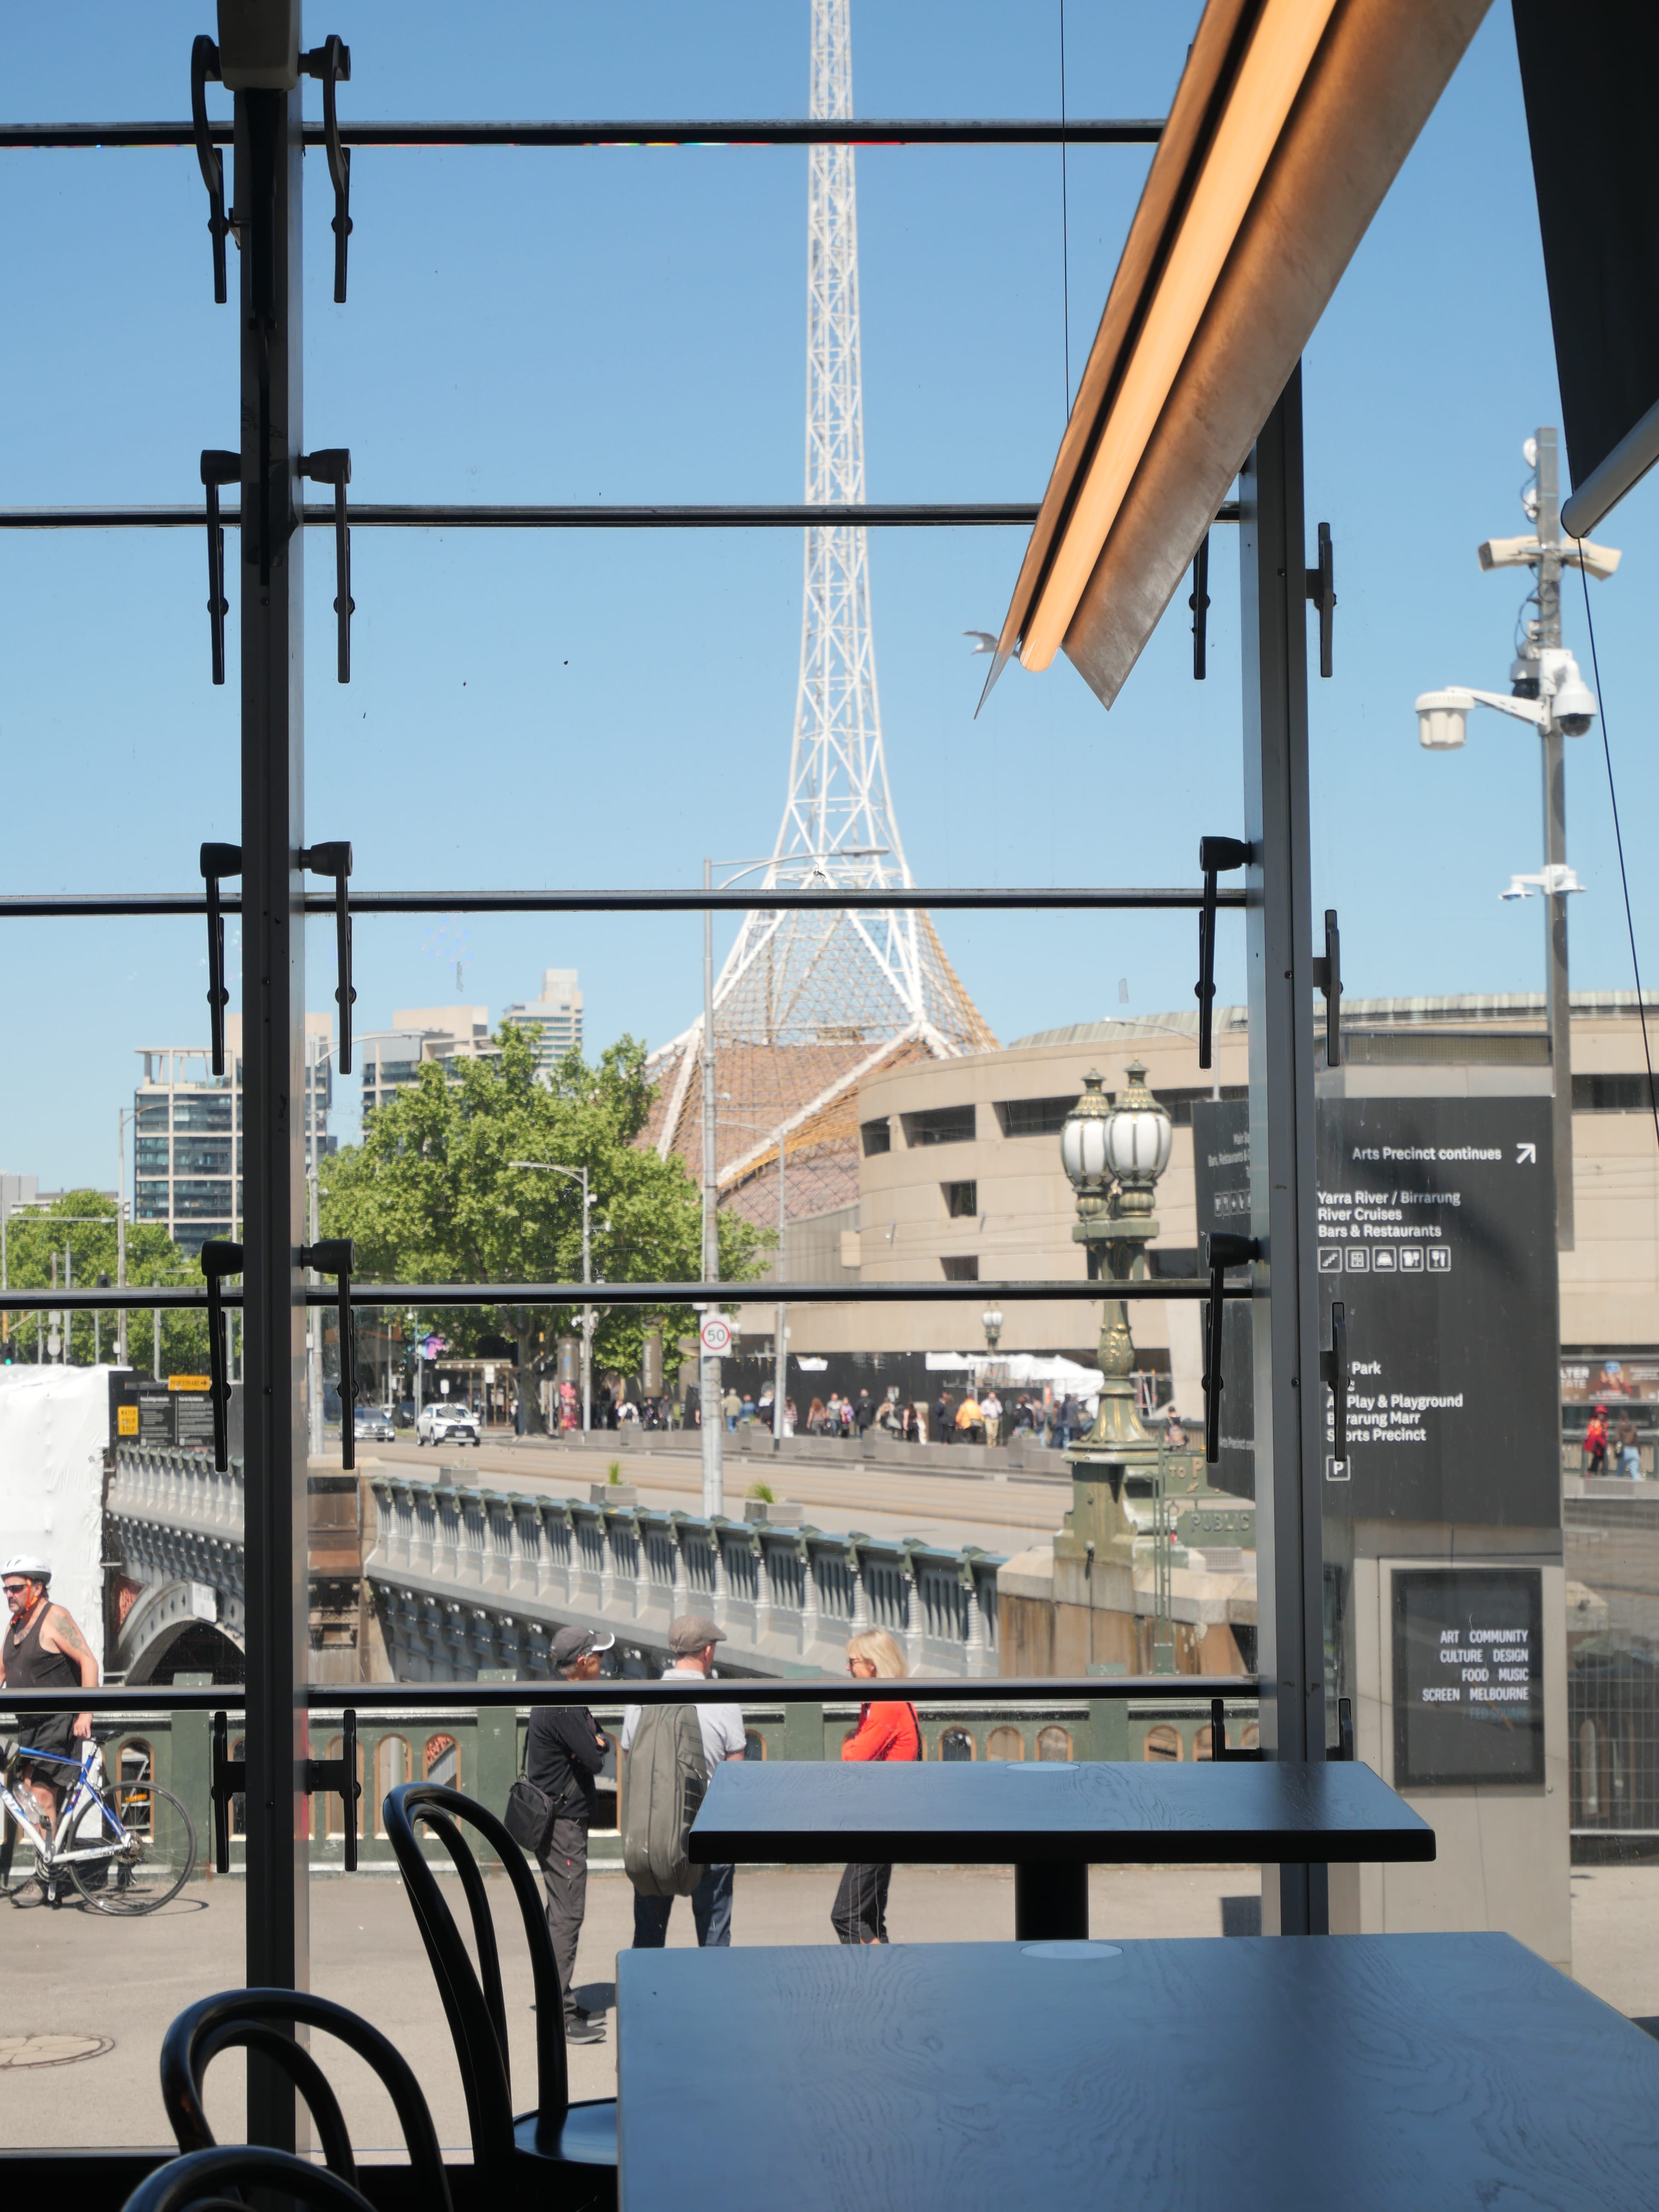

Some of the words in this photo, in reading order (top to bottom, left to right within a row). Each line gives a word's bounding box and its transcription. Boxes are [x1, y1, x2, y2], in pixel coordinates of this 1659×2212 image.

[1352, 1147, 1379, 1160] Arts
[1382, 1146, 1436, 1160] Precinct
[1438, 1146, 1502, 1160] continues
[1317, 1191, 1352, 1204] Yarra
[1355, 1190, 1388, 1204] River
[1391, 1190, 1397, 1205] /
[1400, 1190, 1461, 1206] Birrarung
[1318, 1207, 1352, 1220] River
[1354, 1207, 1402, 1220] Cruises
[1318, 1225, 1348, 1237] Bars
[1350, 1224, 1360, 1237] &
[1363, 1224, 1442, 1237] Restaurants
[707, 1330, 725, 1342] 50
[1352, 1361, 1381, 1374] Park
[1377, 1394, 1388, 1408] &
[1391, 1393, 1463, 1410] Playground
[1327, 1412, 1388, 1427] Brarung
[1390, 1411, 1421, 1424] Marr
[1327, 1429, 1370, 1442] Sorts
[1373, 1427, 1426, 1441] Precinct
[1169, 1466, 1187, 1479] TO
[1190, 1514, 1250, 1532] PUBLIC
[1440, 1630, 1460, 1643] ART
[1469, 1629, 1528, 1643] COMMUNITY
[1440, 1649, 1483, 1663] CULTURE
[1493, 1648, 1529, 1662] DESIGN
[1461, 1668, 1489, 1682] FOOD
[1499, 1668, 1529, 1681] MUSIC
[1422, 1688, 1460, 1702] SCREEN
[1470, 1686, 1529, 1701] MELBOURNE
